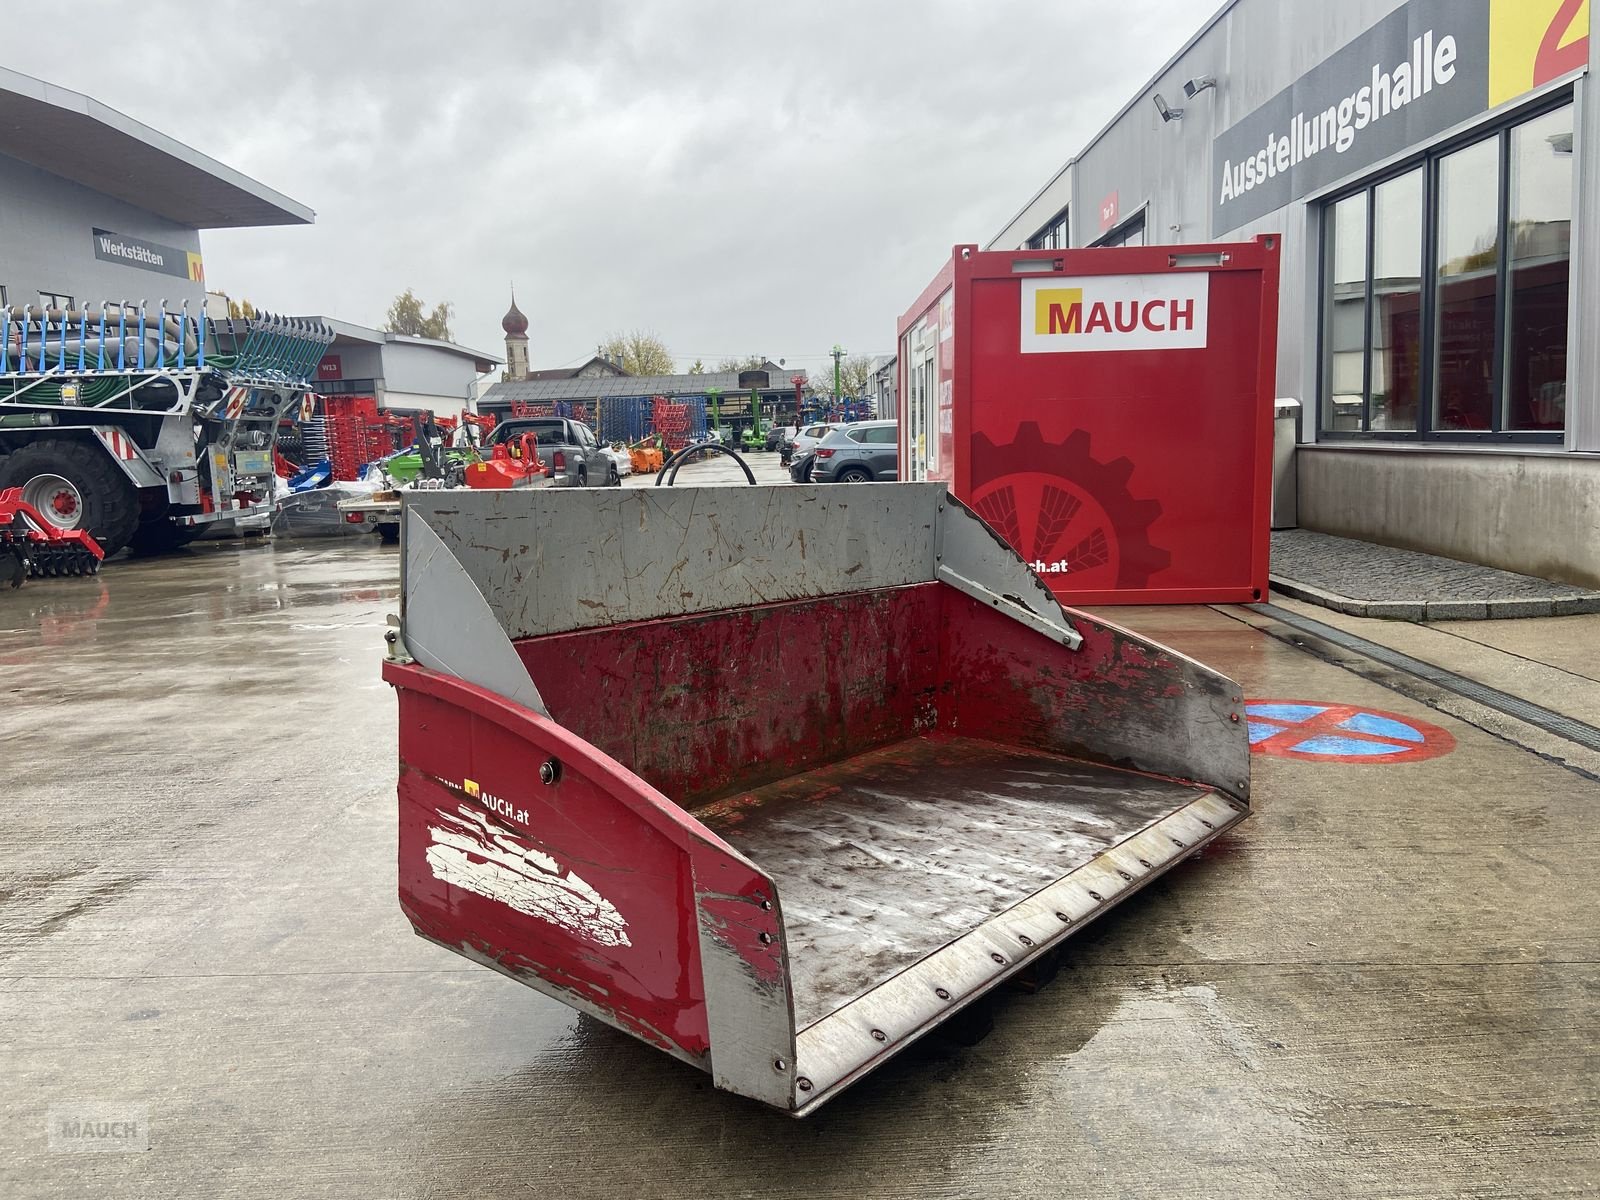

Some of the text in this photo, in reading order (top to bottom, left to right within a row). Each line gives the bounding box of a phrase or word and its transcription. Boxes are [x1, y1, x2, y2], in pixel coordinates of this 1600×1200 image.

[1219, 29, 1458, 206] Ausstellungshalle
[99, 237, 164, 267] Werkstätten
[1048, 298, 1195, 335] MAUCH
